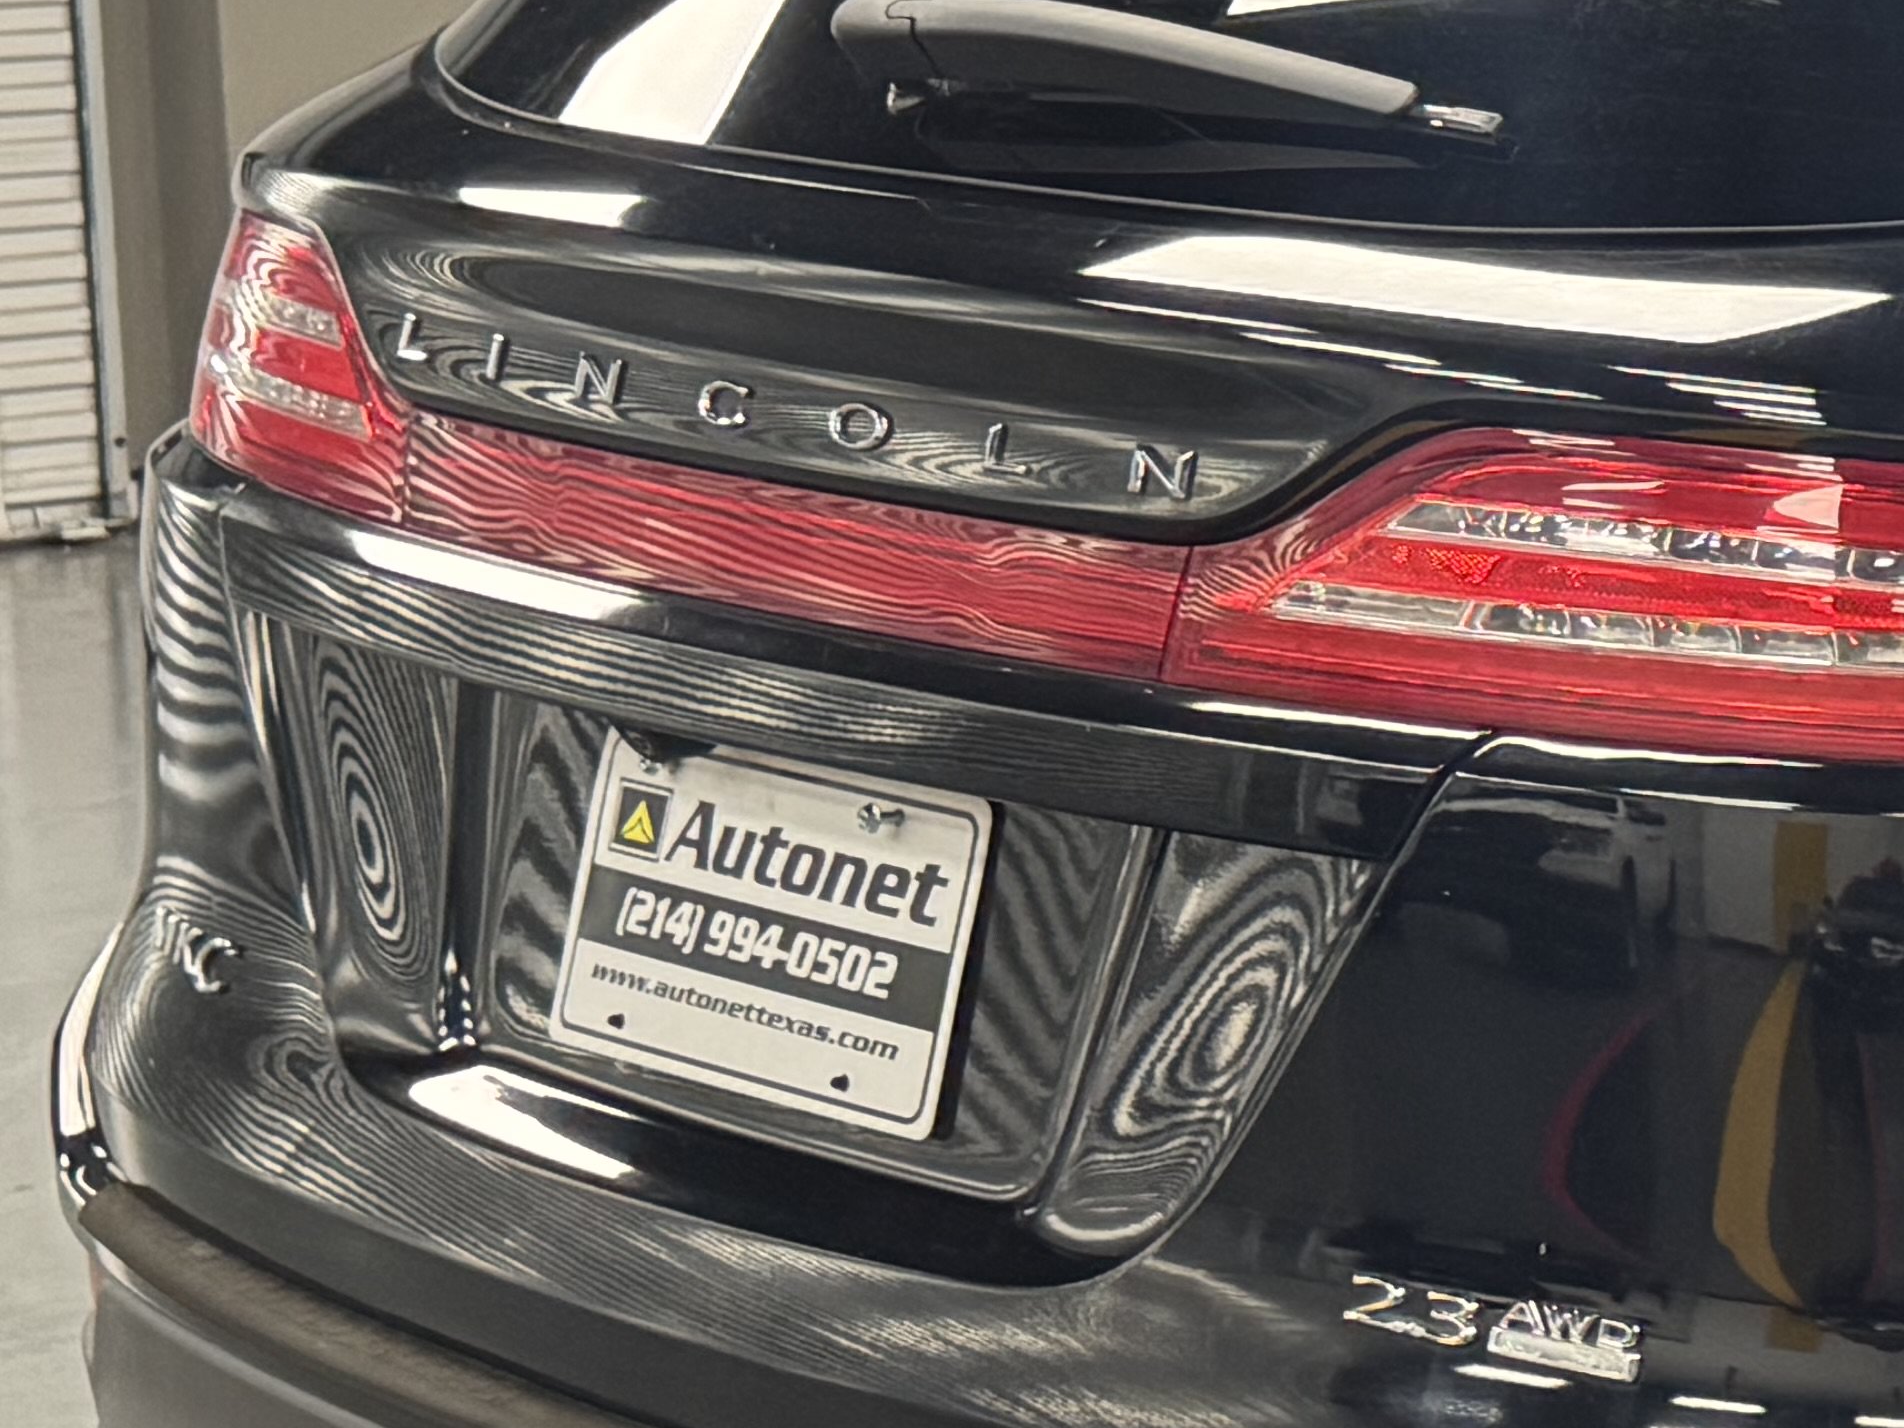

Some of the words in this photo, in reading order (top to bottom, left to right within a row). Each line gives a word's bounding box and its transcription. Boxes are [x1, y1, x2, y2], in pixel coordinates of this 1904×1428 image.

[395, 312, 1199, 501] LINCOLN
[664, 800, 949, 929] Autonet
[614, 885, 704, 955] (214)
[703, 917, 899, 1000] 994-0502
[590, 961, 900, 1062] www.autonettexas.com
[1497, 1298, 1643, 1356] AWD
